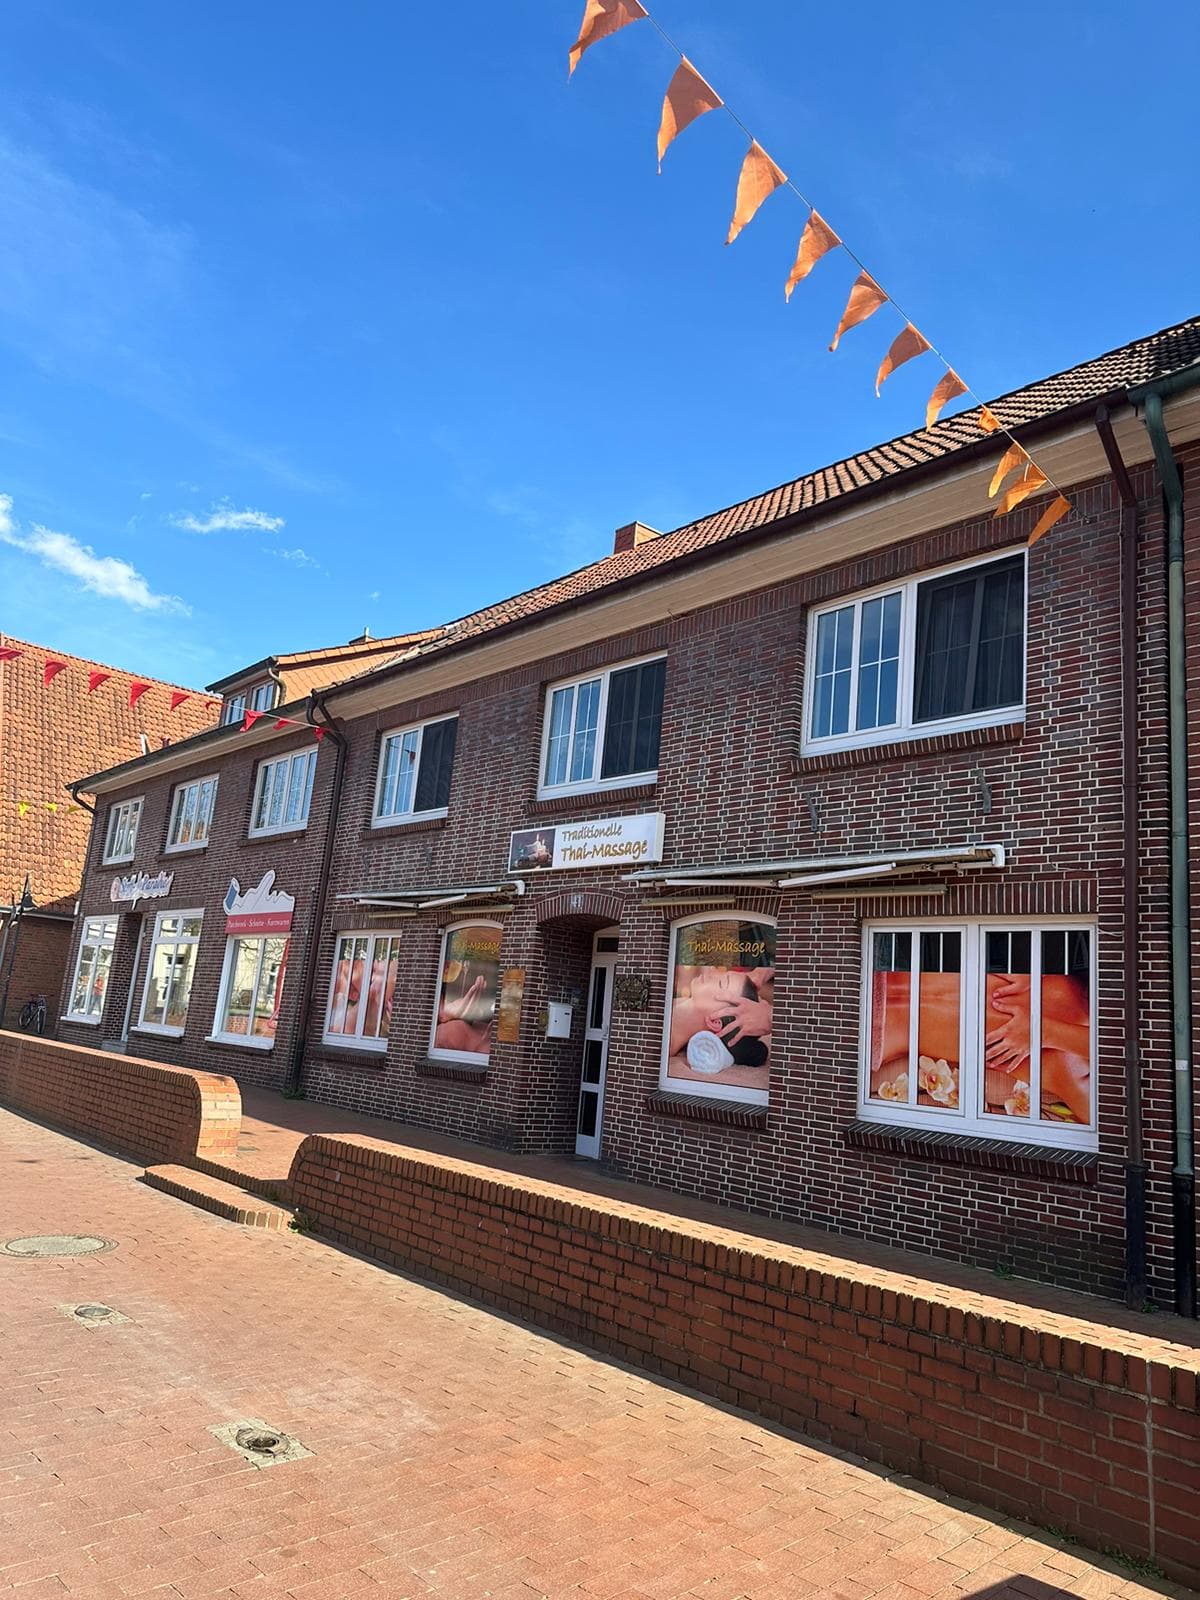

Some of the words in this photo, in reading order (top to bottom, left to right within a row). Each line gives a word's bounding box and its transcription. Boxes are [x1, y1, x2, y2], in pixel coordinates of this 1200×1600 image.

[561, 822, 623, 843] Traditionelle
[560, 839, 648, 861] Thai-Massage
[687, 938, 766, 958] Thai-Massage
